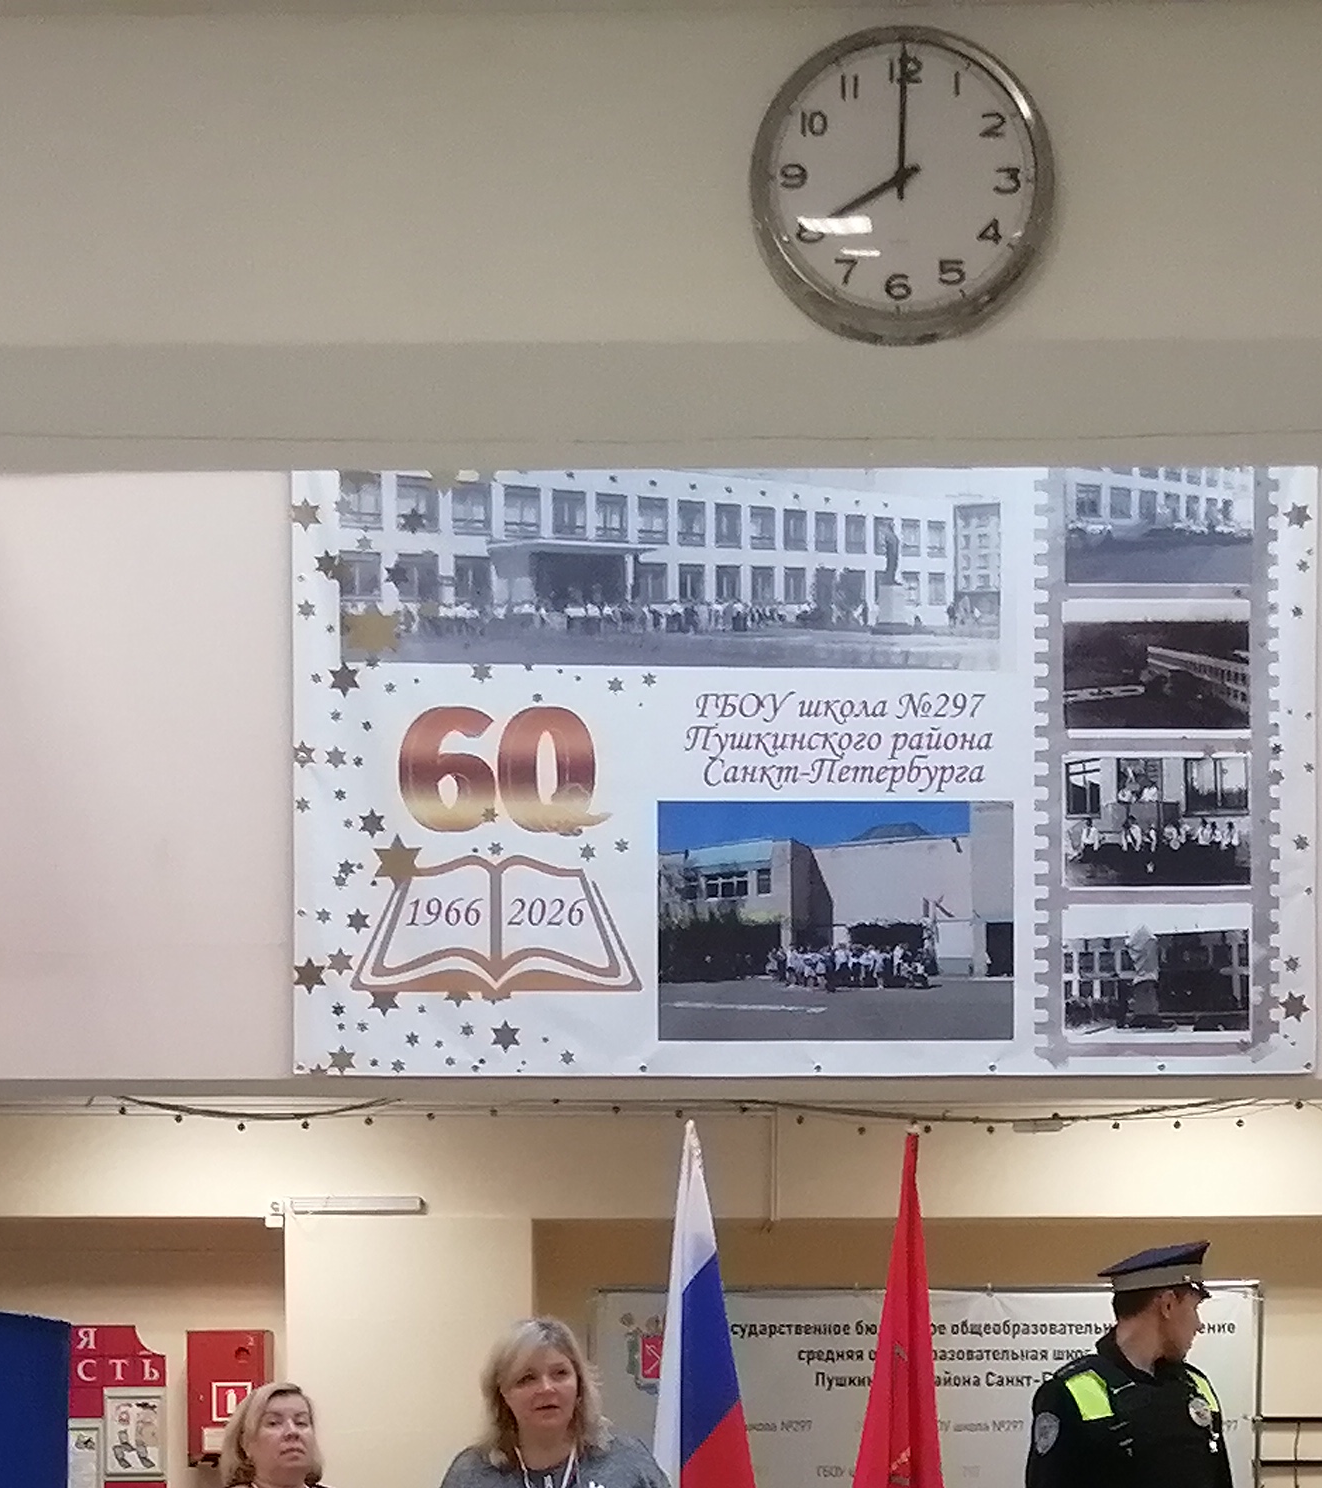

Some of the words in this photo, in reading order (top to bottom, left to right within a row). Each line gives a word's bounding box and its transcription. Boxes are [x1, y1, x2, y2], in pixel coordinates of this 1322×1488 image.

[888, 55, 923, 84] 12
[840, 73, 859, 101] 11
[954, 70, 961, 98] 1
[799, 110, 828, 137] 10
[978, 111, 1007, 139] 2
[779, 163, 808, 189] 9
[992, 166, 1022, 195] 3
[976, 217, 1003, 245] 4
[834, 257, 859, 285] 7
[938, 259, 966, 285] 5
[884, 273, 913, 301] 6
[695, 690, 796, 724] ГБОУ
[797, 698, 888, 725] школа
[894, 691, 986, 720] №297
[683, 723, 882, 759] Пушкинского
[888, 726, 994, 760] района
[398, 705, 596, 833] 60
[702, 754, 987, 793] Санкт-Петербурга
[405, 896, 484, 927] 1966
[506, 896, 587, 927] 2026
[730, 1321, 851, 1339] сударственное
[950, 1321, 1111, 1339] общеобразовательн
[797, 1349, 864, 1365] средняя
